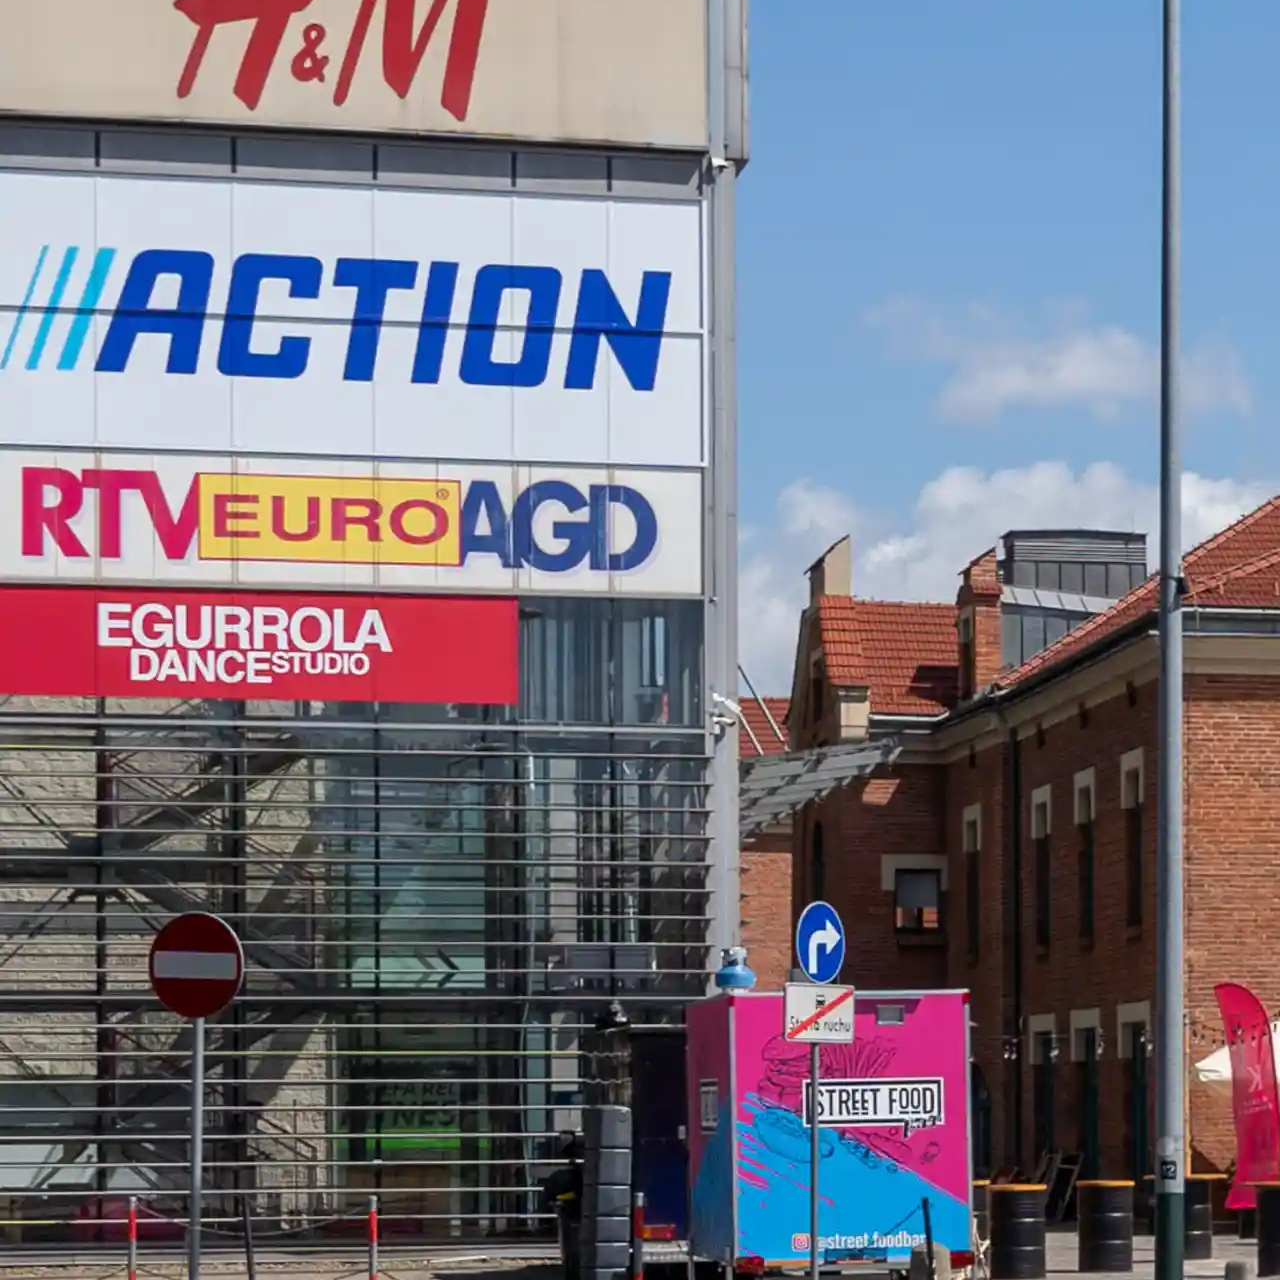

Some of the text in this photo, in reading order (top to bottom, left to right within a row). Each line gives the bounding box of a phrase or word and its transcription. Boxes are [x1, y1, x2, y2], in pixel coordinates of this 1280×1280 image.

[94, 248, 673, 391] ACTION
[21, 466, 200, 560] RTV
[461, 480, 658, 572] AGD
[97, 602, 393, 654] EGURROLA
[130, 648, 371, 684] DANCE STUDIO
[817, 1087, 935, 1117] STREET FOOD
